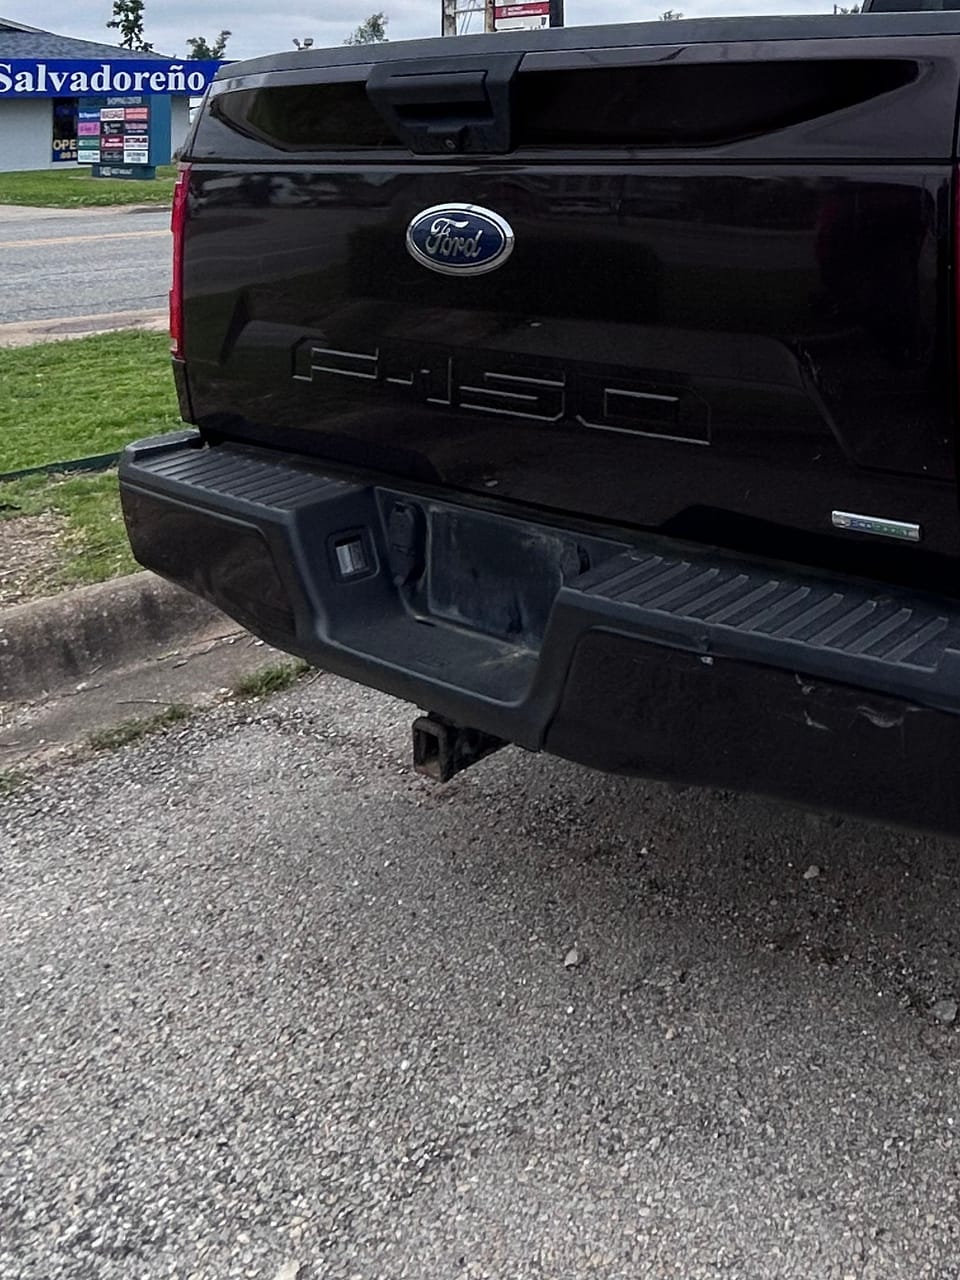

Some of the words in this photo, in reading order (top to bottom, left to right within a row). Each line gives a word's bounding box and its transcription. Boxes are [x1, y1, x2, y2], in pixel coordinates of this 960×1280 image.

[0, 63, 205, 92] Salvadoreño
[53, 139, 77, 150] OPE
[425, 217, 483, 257] Ford
[292, 338, 712, 446] F-150
